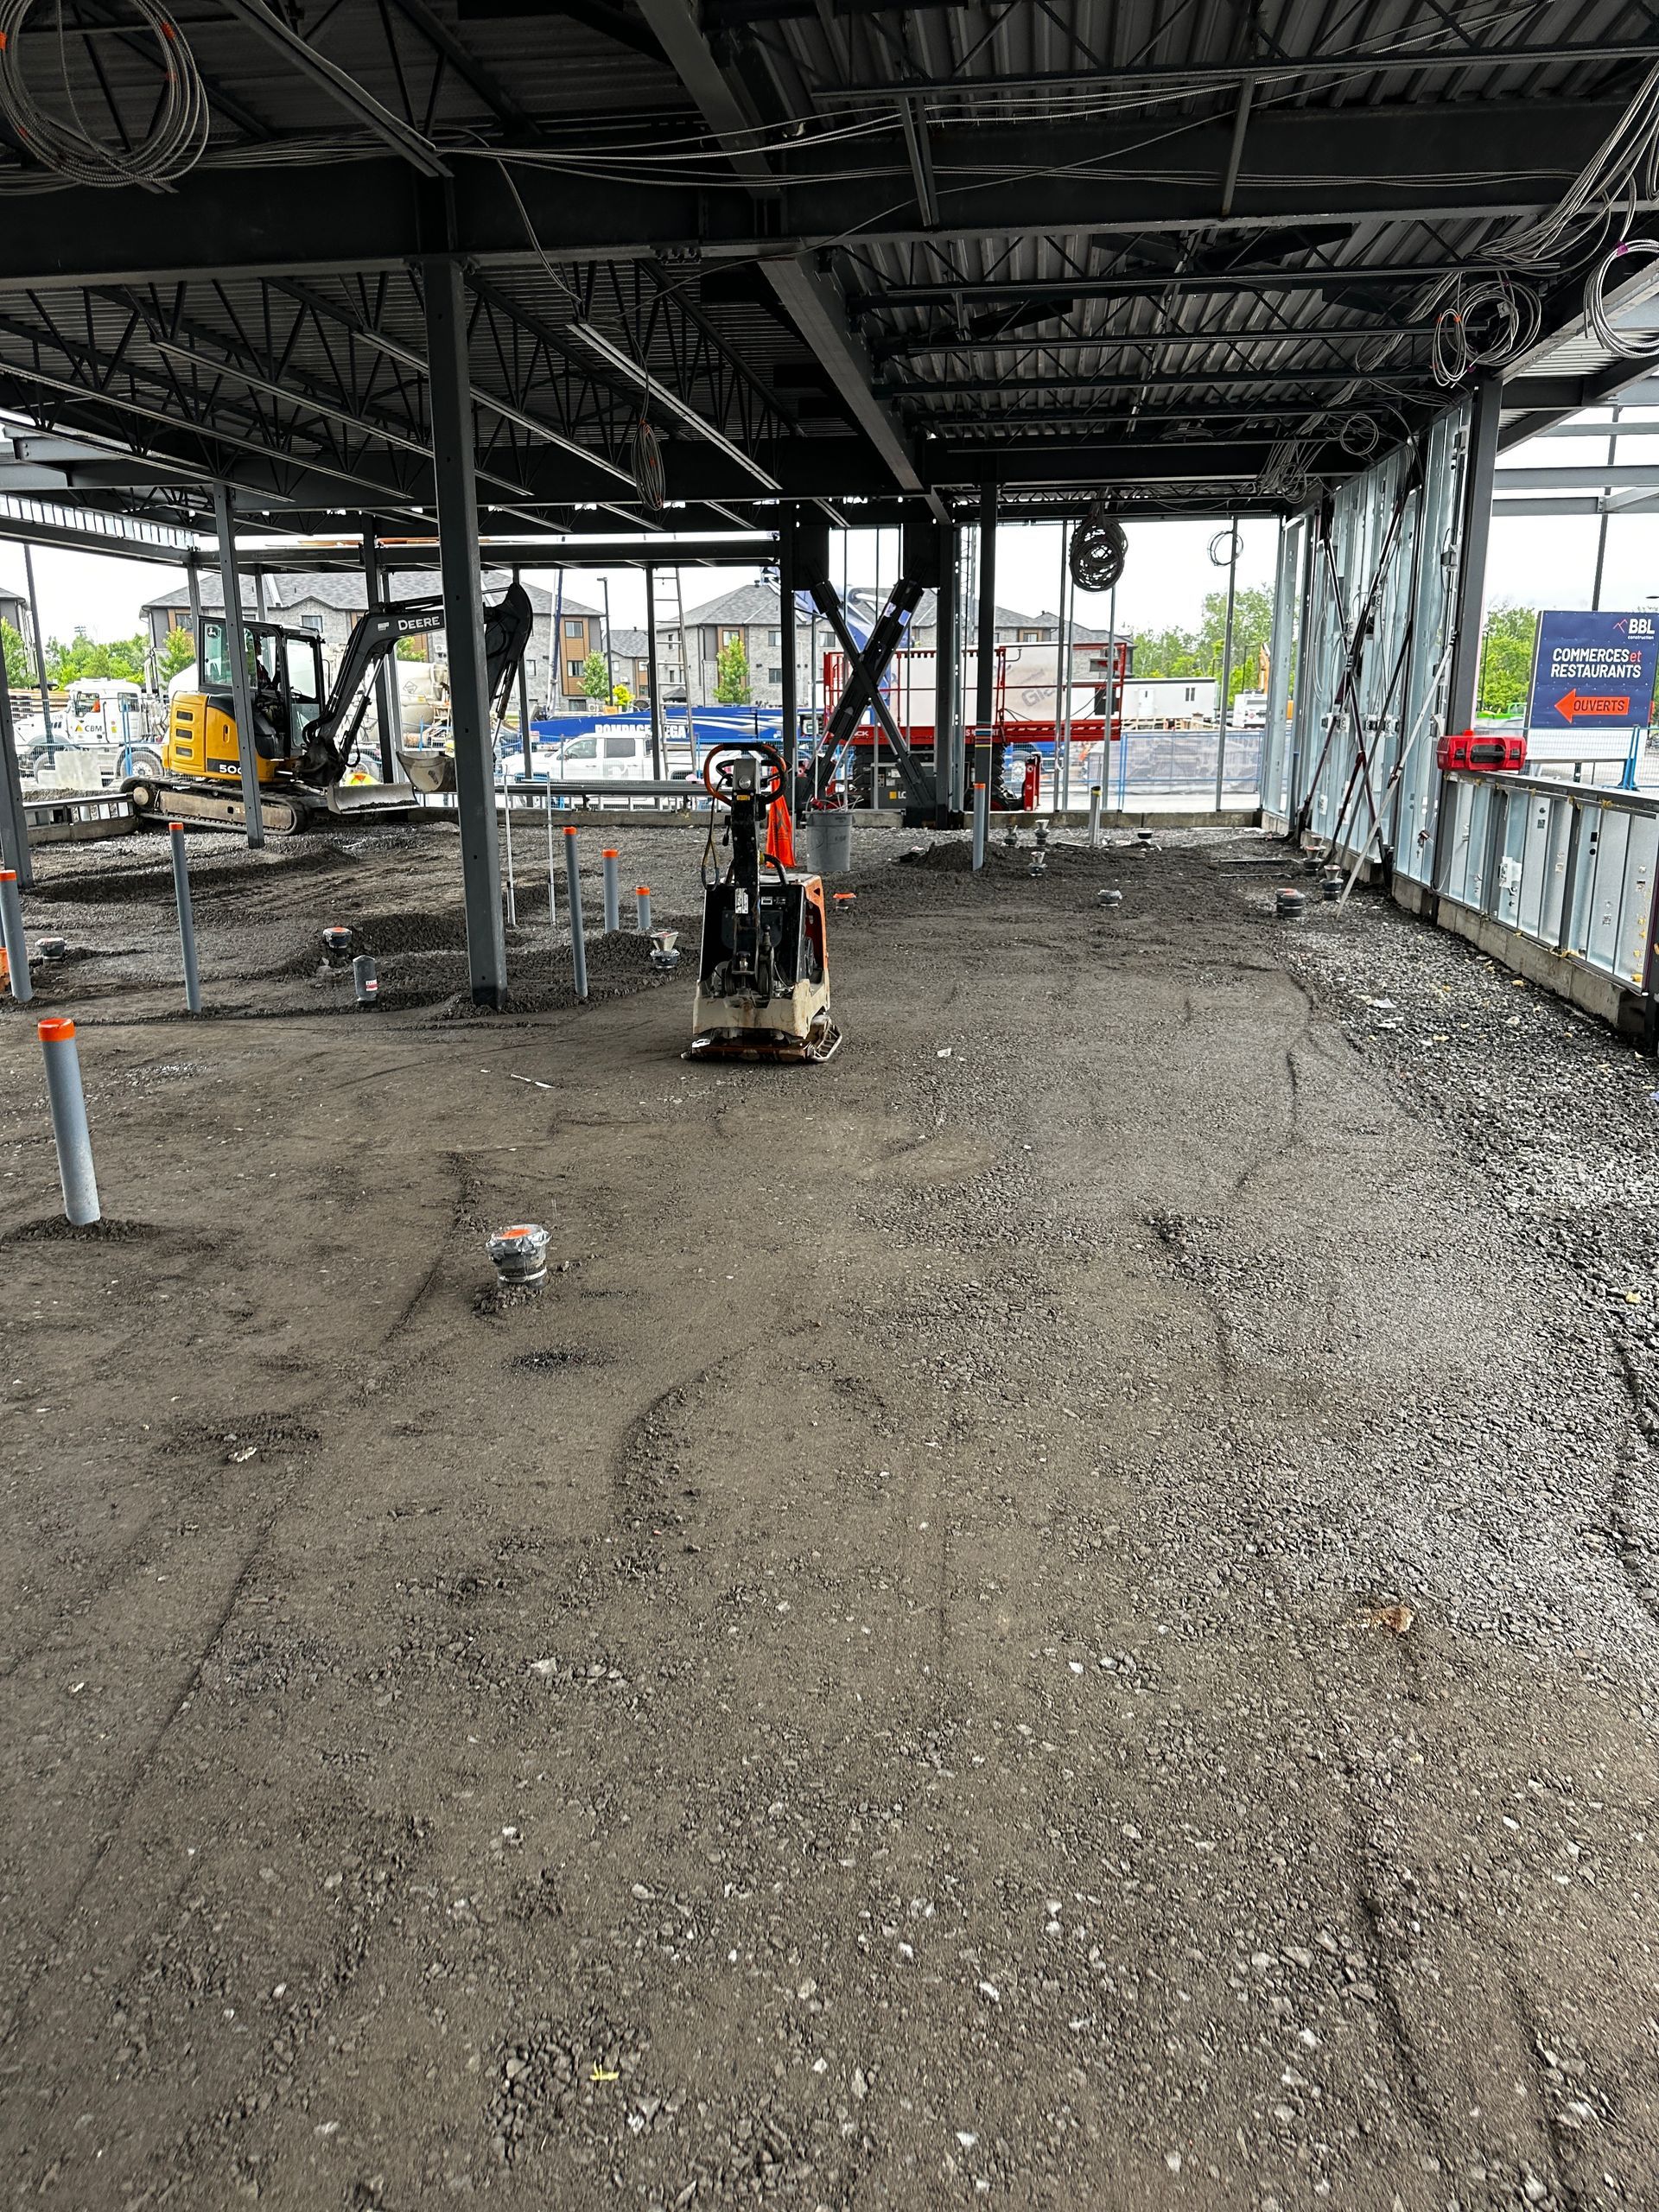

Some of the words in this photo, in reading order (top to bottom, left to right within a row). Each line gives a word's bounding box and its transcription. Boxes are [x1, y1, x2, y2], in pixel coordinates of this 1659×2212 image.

[397, 615, 441, 631] DEERE
[1628, 618, 1656, 634] BBL
[1552, 647, 1630, 663] COMMERCES
[1630, 650, 1643, 663] et
[1550, 664, 1642, 678] RESTAURANTS
[1573, 699, 1625, 712] OUVERTS
